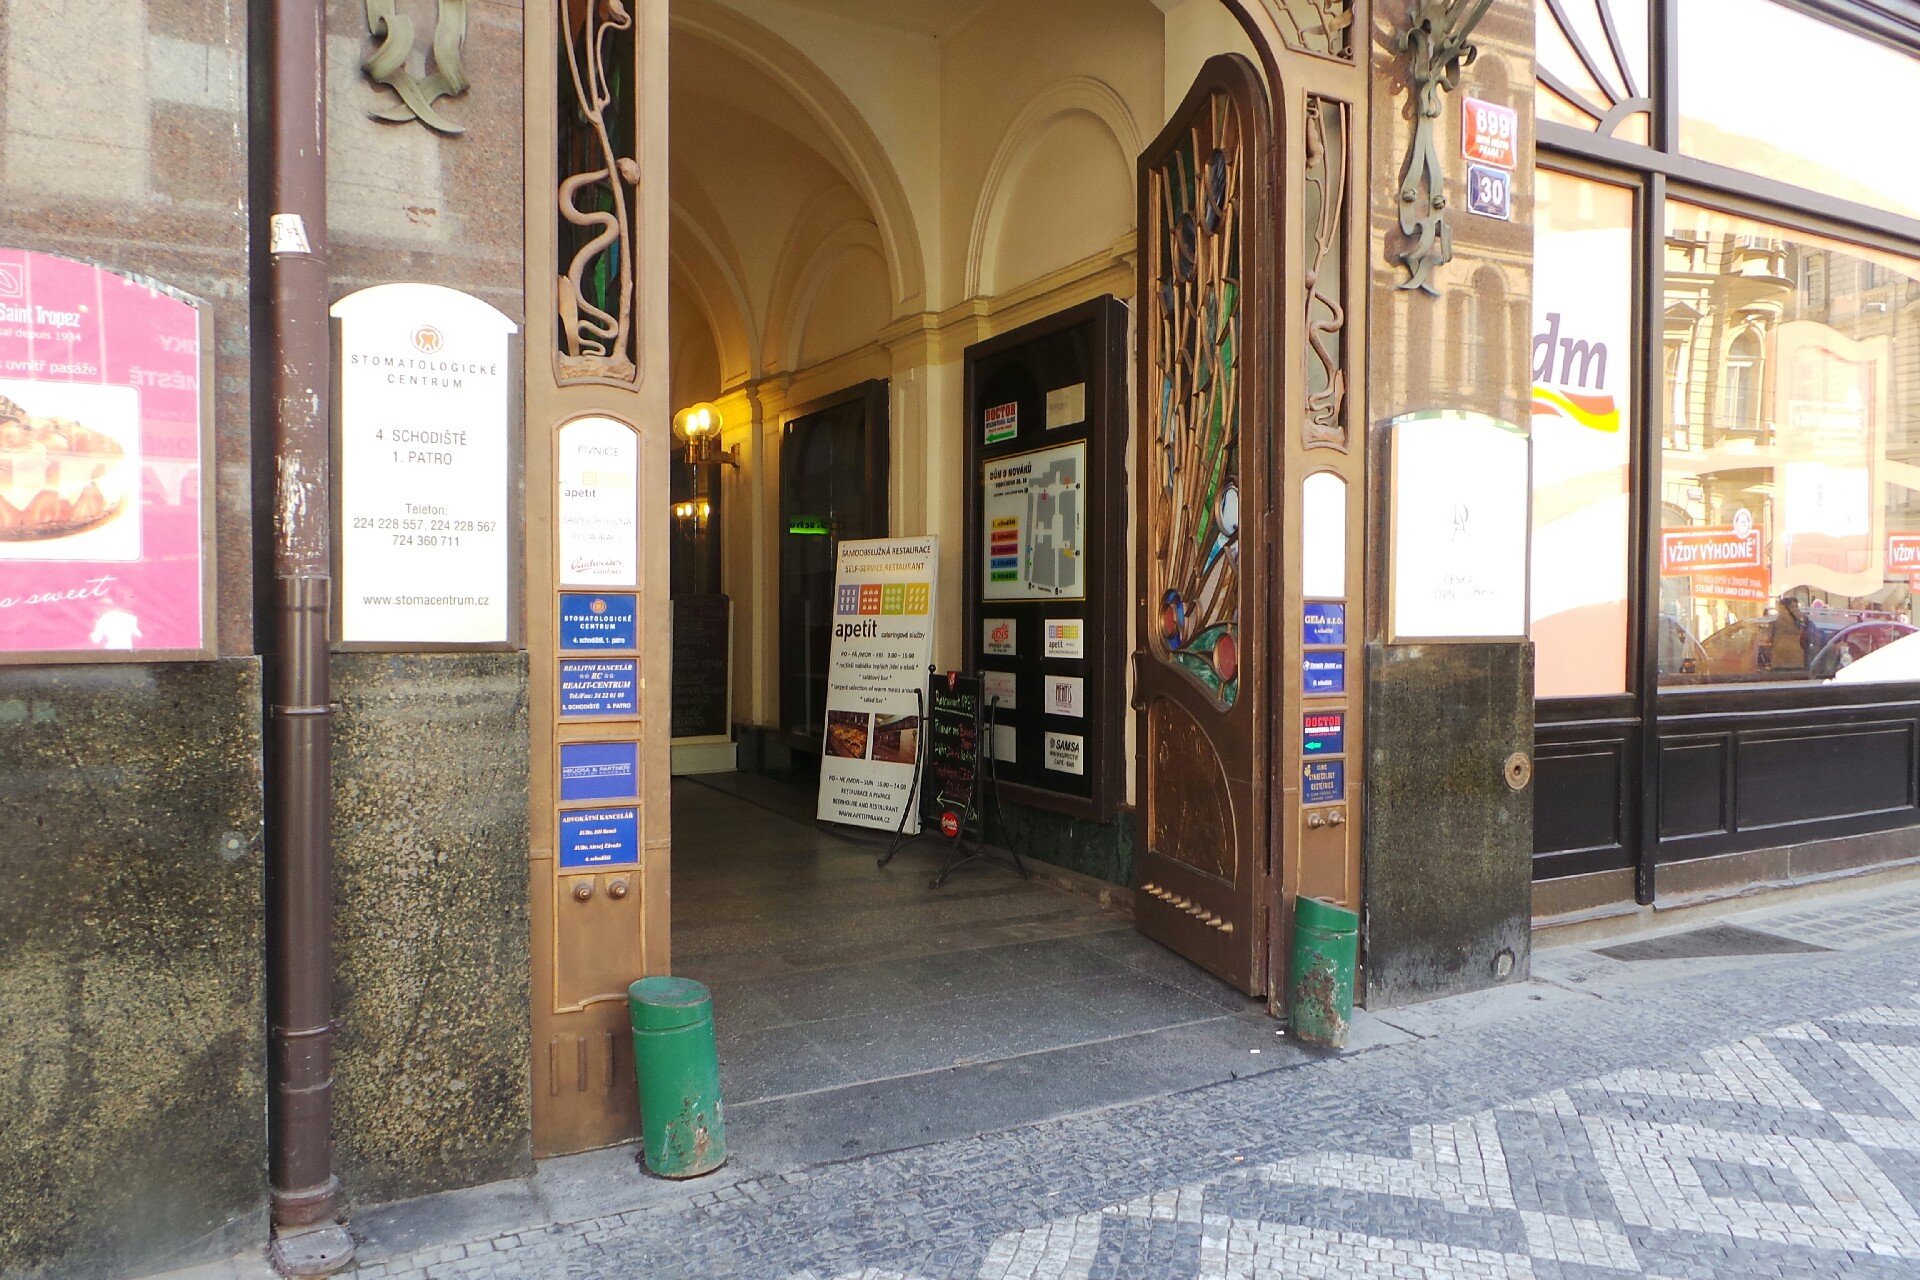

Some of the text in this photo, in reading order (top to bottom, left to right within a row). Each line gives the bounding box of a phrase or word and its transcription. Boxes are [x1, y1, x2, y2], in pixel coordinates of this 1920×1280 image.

[1476, 107, 1510, 139] 699
[1480, 176, 1504, 205] 30
[0, 302, 80, 329] Saint Tropez
[16, 329, 51, 341] depuis
[1533, 312, 1607, 390] dm
[50, 360, 97, 376] pasáže
[351, 354, 496, 376] STOMATOLOGICKÉ
[387, 373, 462, 389] CENTRUM
[986, 404, 1016, 422] DOCTOR
[392, 429, 467, 446] SCHODIŠTĚ
[577, 445, 619, 457] PIVNICE
[393, 450, 453, 466] 1. PATRO
[989, 461, 1032, 480] DŮM U NOVÁKŮ
[564, 488, 596, 500] apetit
[405, 503, 448, 516] Telefon:
[353, 517, 497, 532] 224 228 557, 224 228 567
[392, 534, 459, 547] 724 360 711
[841, 545, 931, 557] SAMOOBSLUŽNÁ RESTAURACE
[1668, 537, 1753, 562] VŽDY VÝHODNĚ
[1893, 543, 1916, 561] VŽDY
[845, 562, 925, 573] SELF-SERVICE RESTAURANT
[24, 574, 118, 605] sweet
[362, 594, 490, 606] www.stomacentrum.cz
[563, 614, 632, 622] STOMATOLOGICKÉ
[1304, 615, 1325, 624] GELA
[835, 619, 926, 642] apetit cateringové služby
[591, 672, 603, 680] RC
[562, 681, 631, 690] REALIT-CENTRUM
[863, 696, 875, 704] salad
[1304, 716, 1341, 727] DOCTOR
[1056, 740, 1080, 753] SAMSA
[841, 787, 869, 798] RESTAURACE
[858, 801, 869, 809] AND
[869, 803, 899, 813] RESTAURANT
[562, 812, 633, 823] ADVOKÁTNÍ KANCELÁŘ
